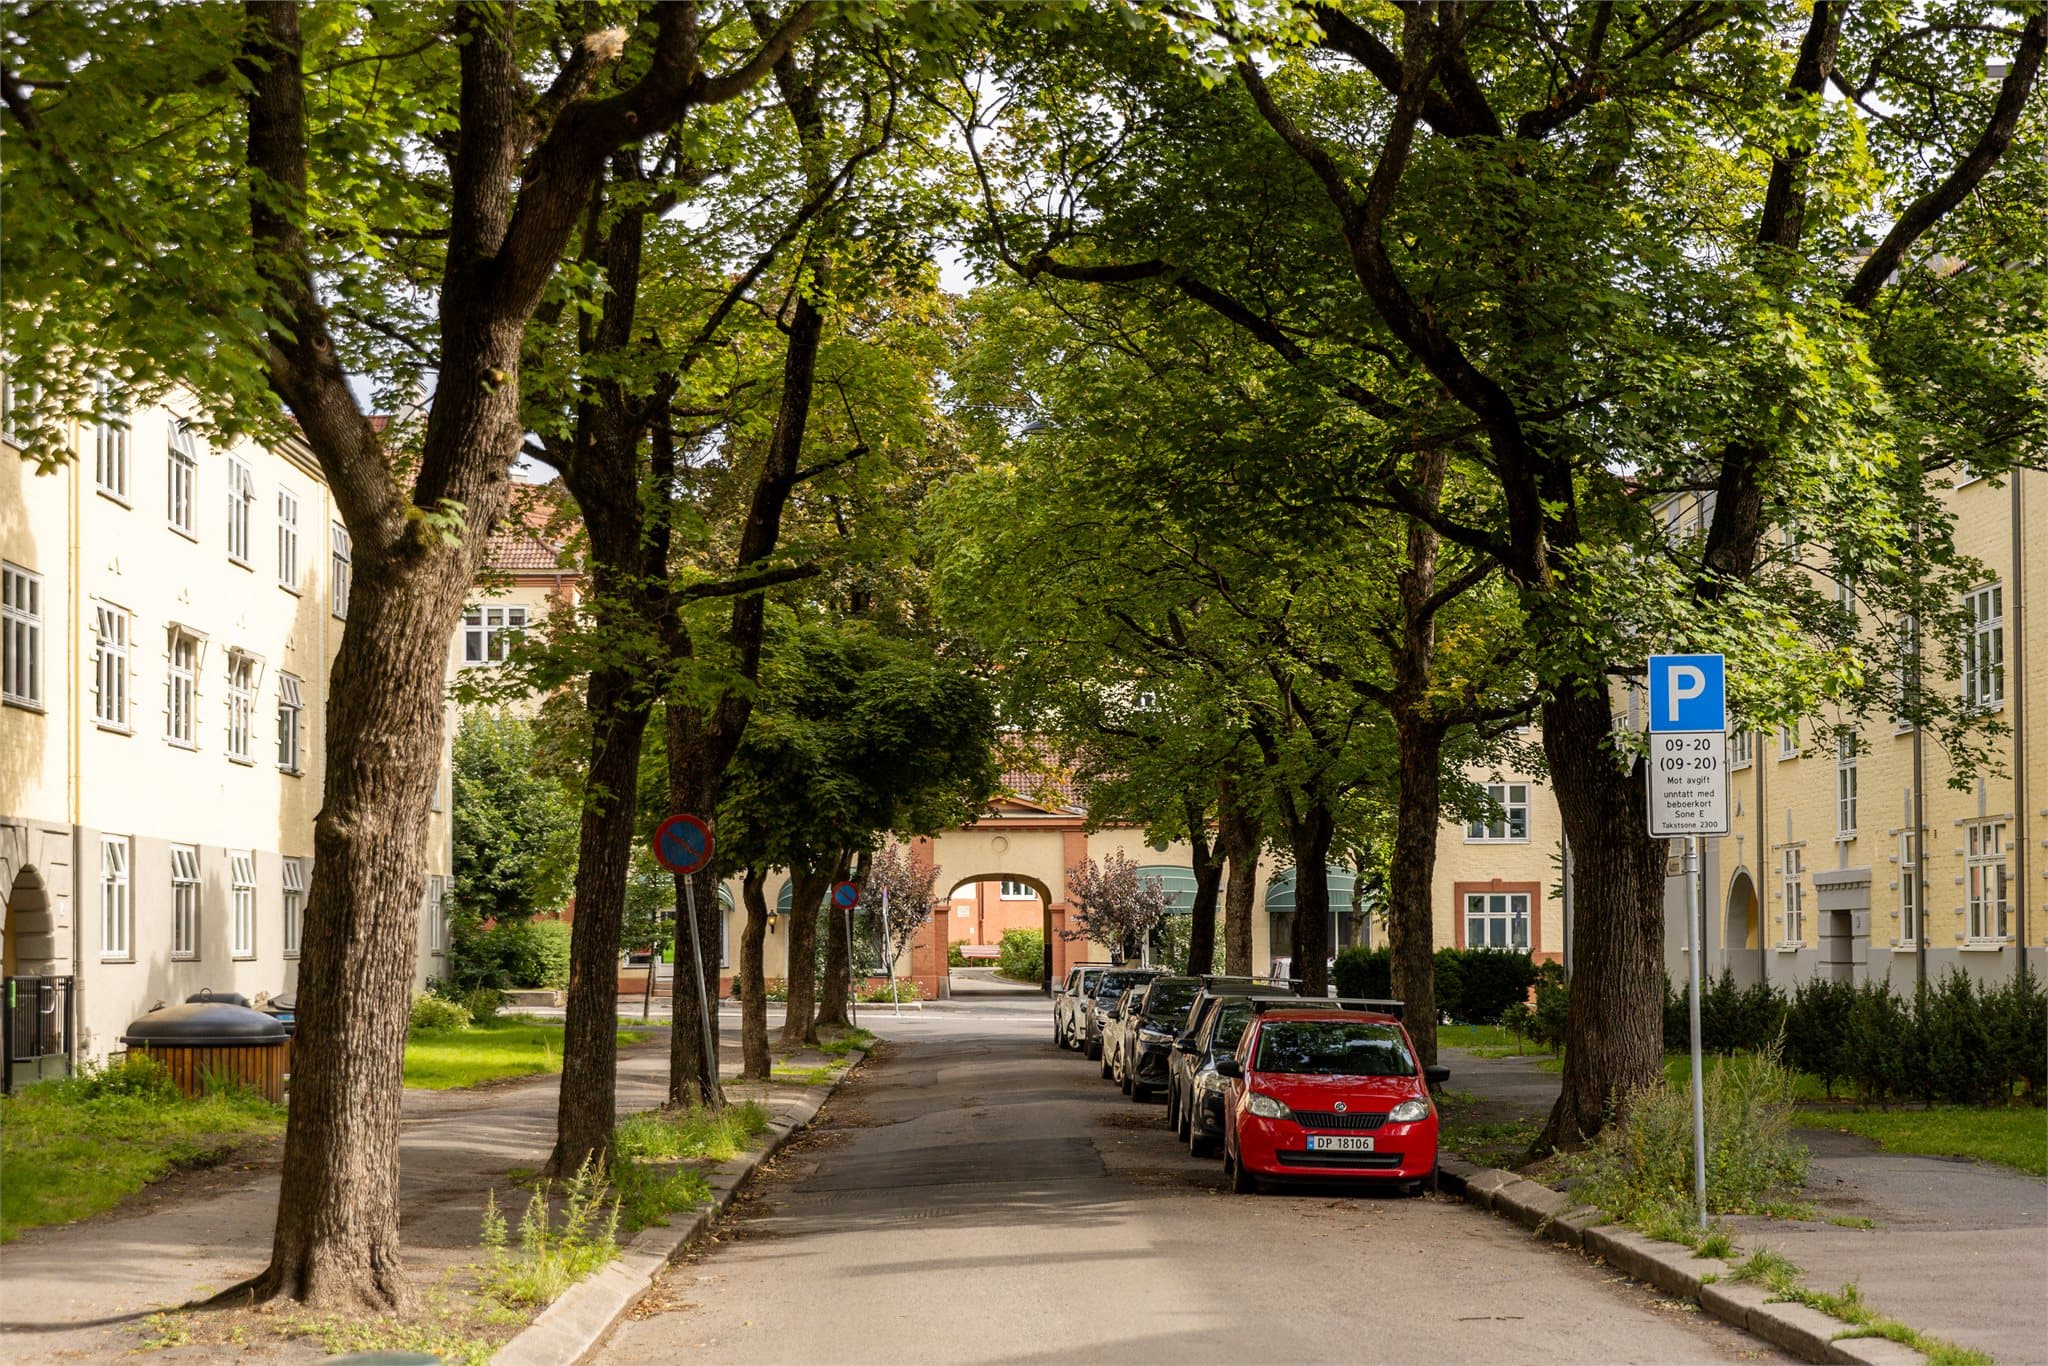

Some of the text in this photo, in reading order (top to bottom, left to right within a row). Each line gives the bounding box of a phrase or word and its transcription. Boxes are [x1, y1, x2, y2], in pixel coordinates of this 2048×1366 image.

[1667, 665, 1706, 722] P
[1667, 776, 1711, 786] Mot avgift
[1663, 789, 1715, 798] unntatt med
[1666, 800, 1712, 808] beboerkort
[1675, 810, 1705, 818] Sone E
[1317, 1137, 1369, 1149] DP 18106
